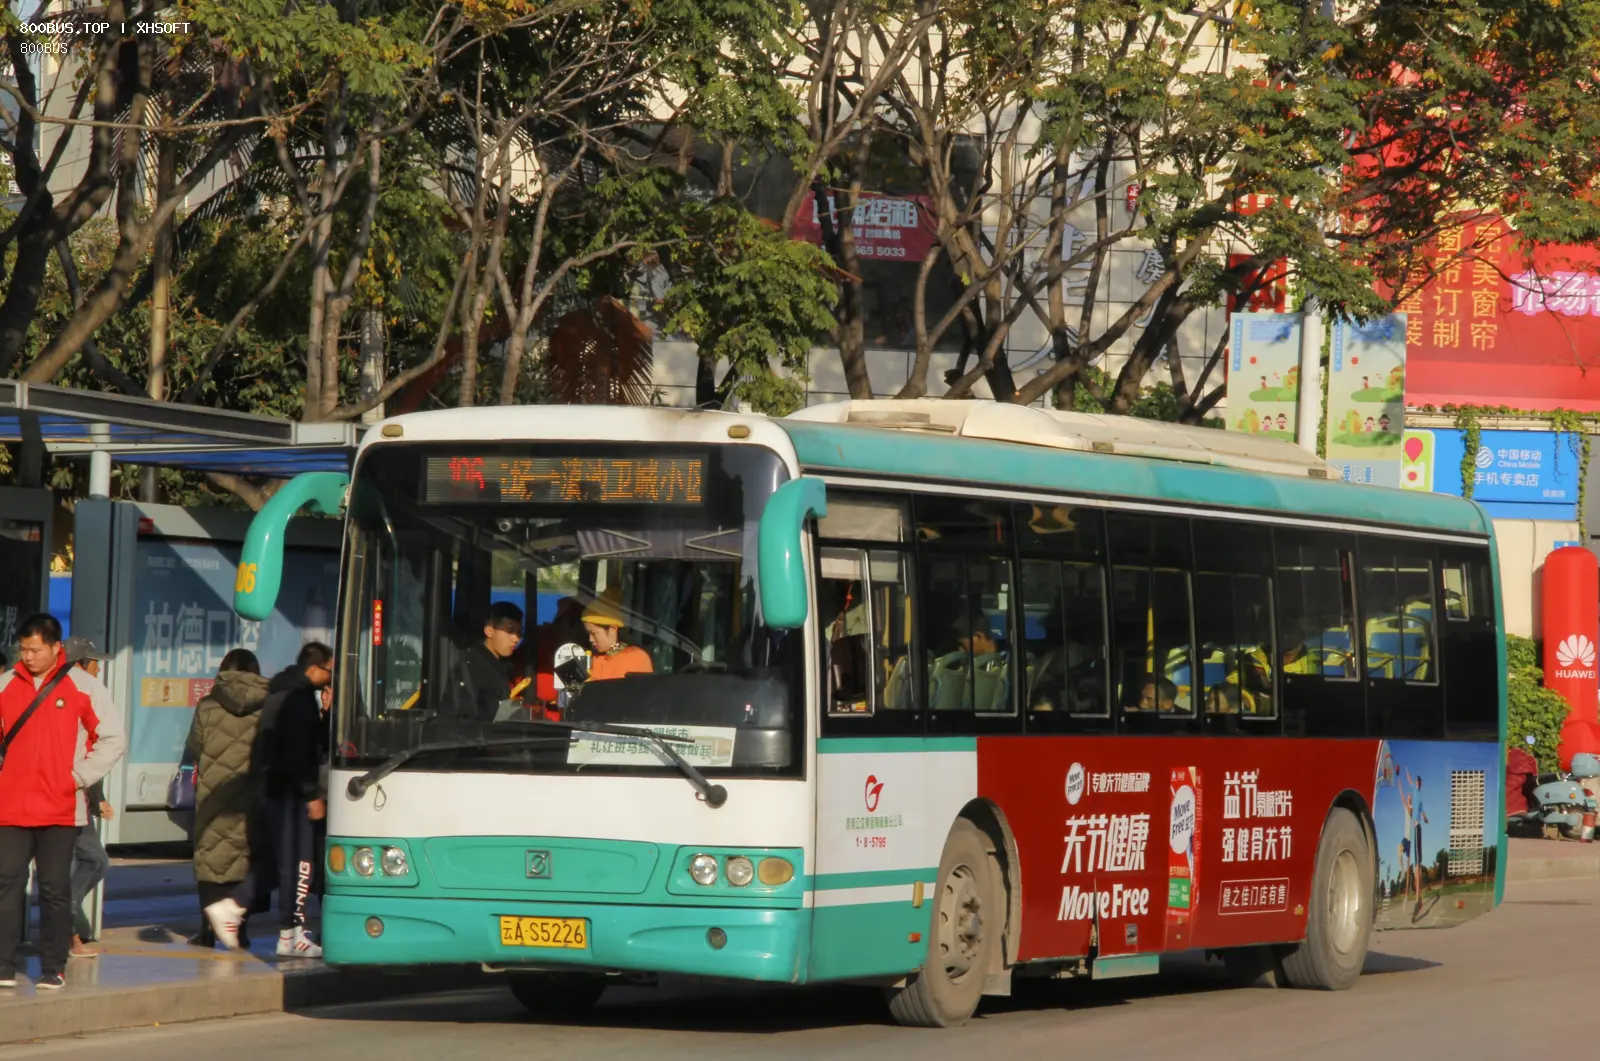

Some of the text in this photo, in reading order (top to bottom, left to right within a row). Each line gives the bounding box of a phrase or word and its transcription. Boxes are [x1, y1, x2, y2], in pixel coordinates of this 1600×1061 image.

[876, 246, 906, 257] 5033
[1470, 224, 1501, 351] 完美窗帘
[1498, 449, 1542, 460] 中国移动
[1336, 464, 1372, 484] 爱儿童
[1473, 471, 1540, 487] 手机专卖店
[1555, 669, 1596, 679] HUAWEI
[1092, 772, 1151, 793] 专业关节健康品牌
[1060, 811, 1151, 874] 关节健康
[1221, 825, 1293, 862] 强健骨关节
[1057, 885, 1110, 921] Move
[1111, 883, 1150, 918] Free
[1222, 883, 1287, 908] 健之佳门店有售
